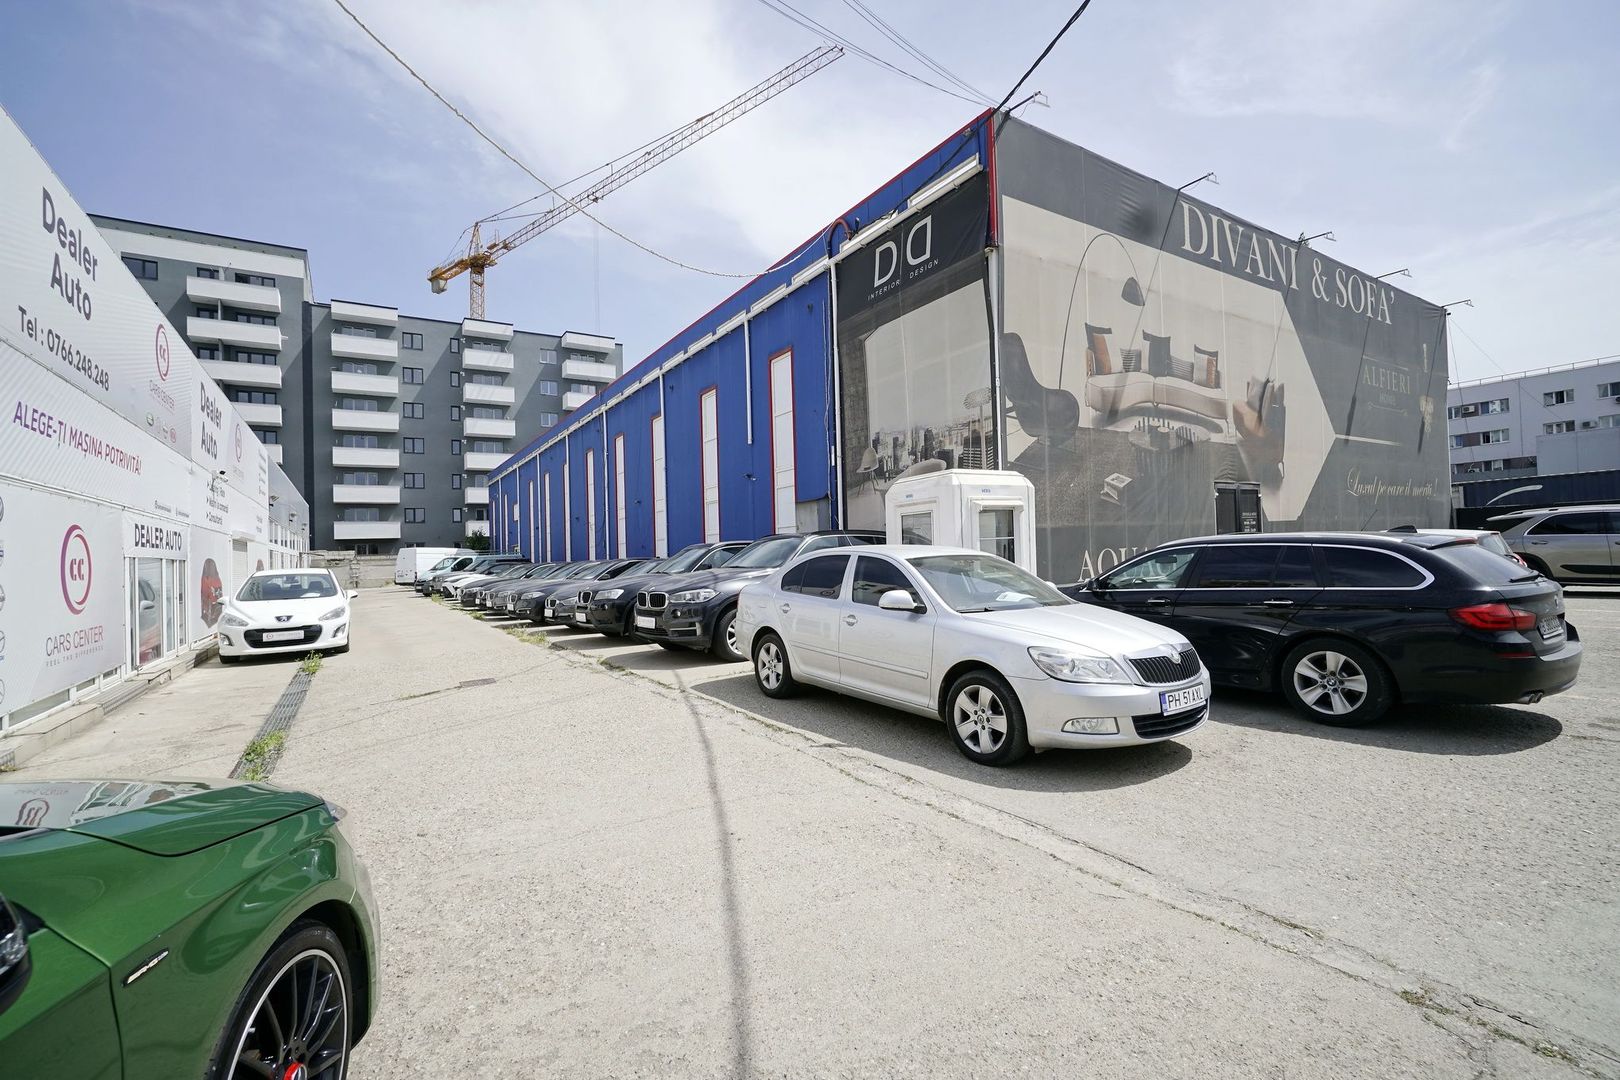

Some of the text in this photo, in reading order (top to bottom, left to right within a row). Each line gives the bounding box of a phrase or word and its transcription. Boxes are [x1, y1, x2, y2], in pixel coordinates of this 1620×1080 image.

[42, 186, 98, 282] Dealer
[1180, 200, 1299, 291] DIVANI
[1311, 258, 1331, 303] &
[50, 252, 92, 321] Auto
[867, 258, 939, 301] INTERIOR DESIGN
[47, 328, 110, 392] 0766.248.248
[1362, 364, 1411, 395] ALFIERI
[200, 381, 222, 431] Dealer
[201, 421, 218, 460] Auto
[134, 523, 182, 551] DEALER AUTO
[45, 625, 104, 657] CARS CENTER
[1167, 692, 1182, 709] PH
[1182, 689, 1191, 704] 51
